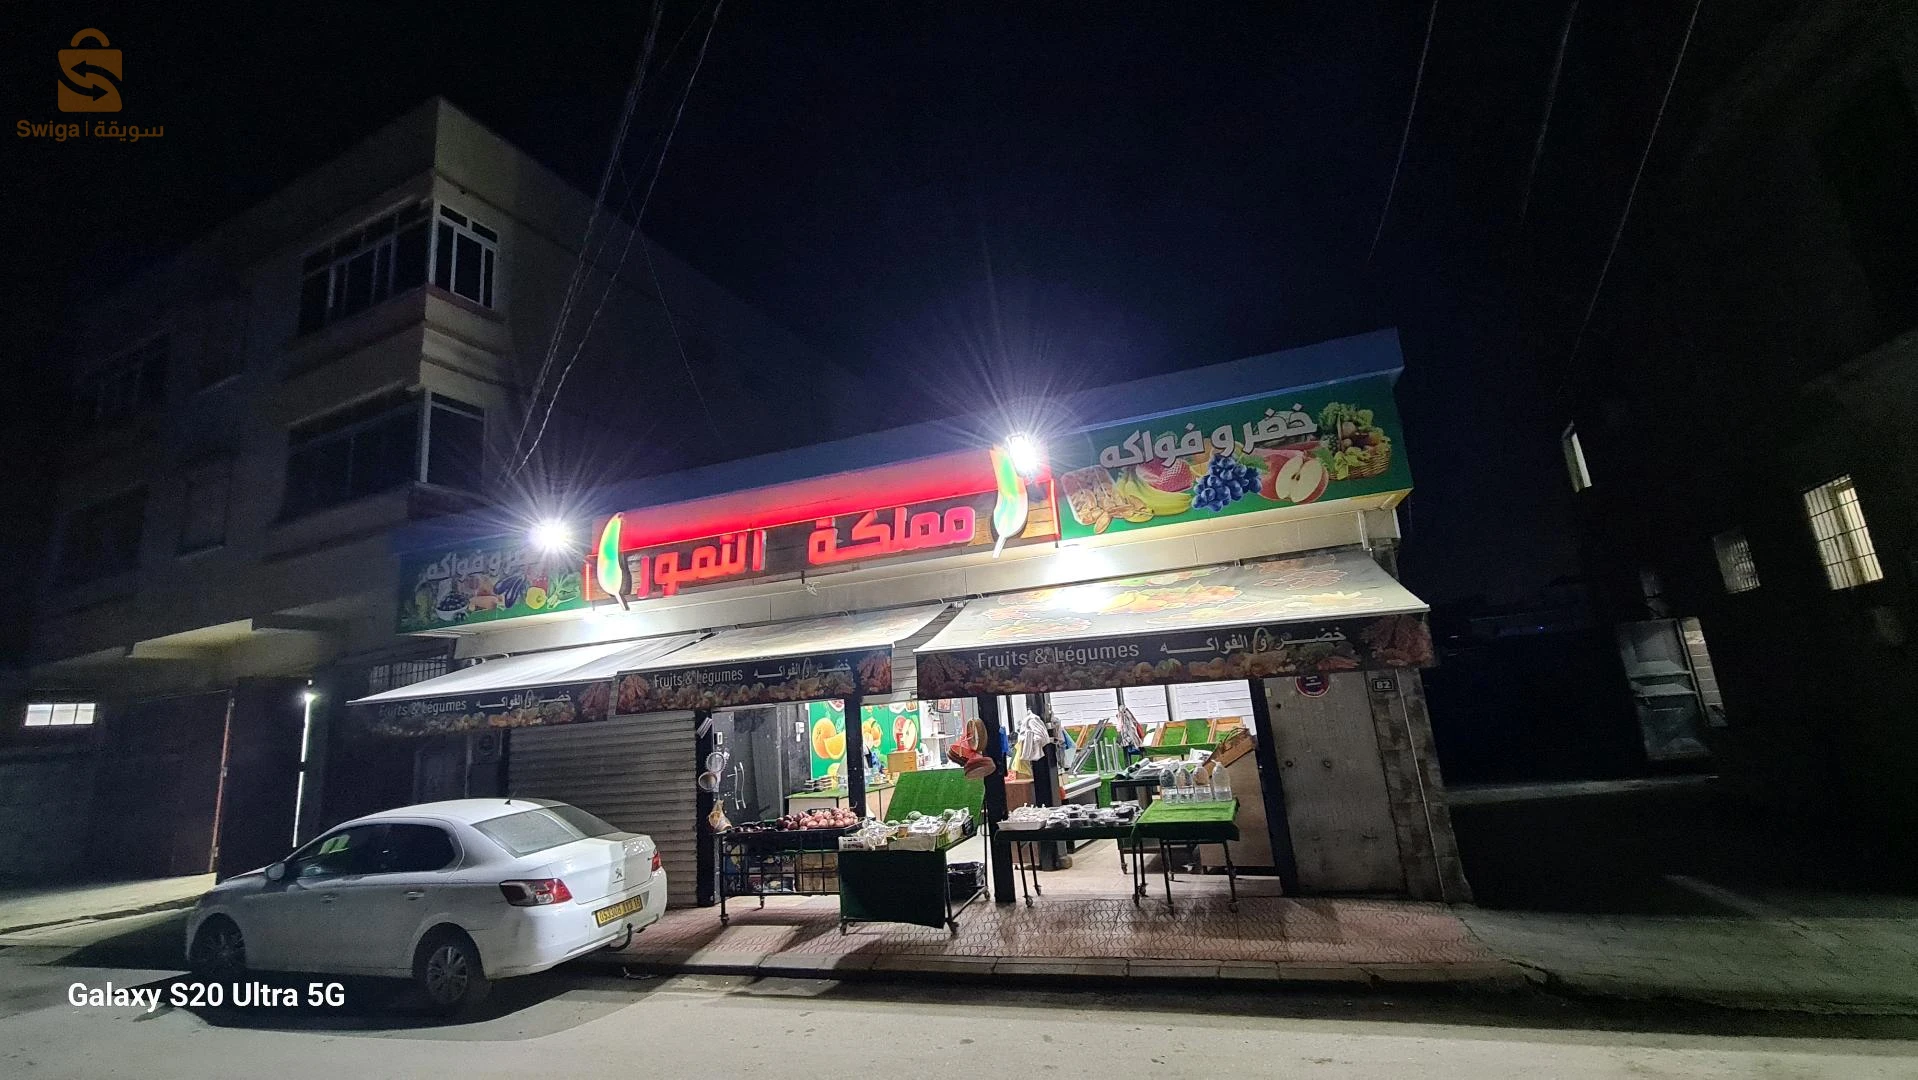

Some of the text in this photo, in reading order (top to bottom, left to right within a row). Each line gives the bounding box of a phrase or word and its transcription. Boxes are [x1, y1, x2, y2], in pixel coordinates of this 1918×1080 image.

[1099, 402, 1318, 468] خضر و فواكه
[637, 505, 976, 599] مملكة التمور
[1158, 636, 1249, 655] الفواكه
[1277, 627, 1347, 651] خضر
[976, 643, 1140, 669] Fruits & Légumes
[653, 668, 744, 688] Fruits & Légumes
